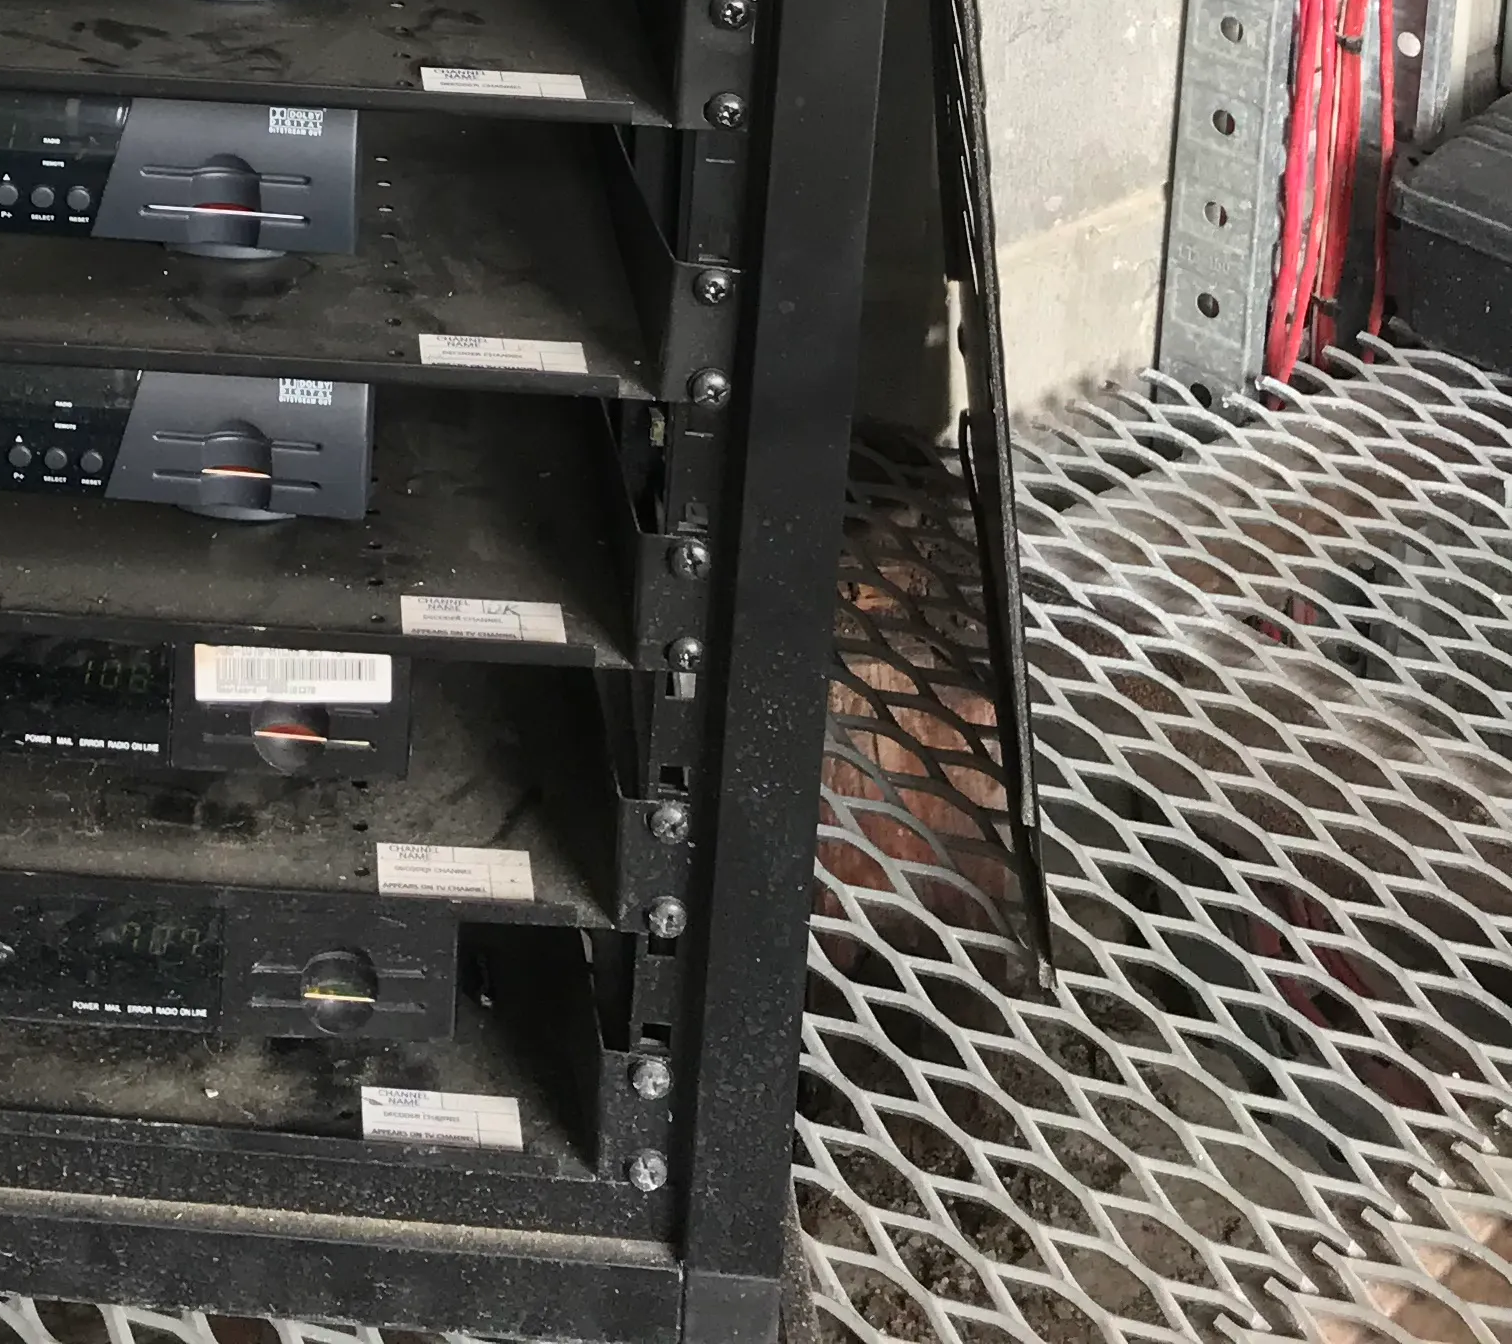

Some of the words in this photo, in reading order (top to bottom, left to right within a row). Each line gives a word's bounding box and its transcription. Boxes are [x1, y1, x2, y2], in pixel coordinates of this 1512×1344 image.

[25, 734, 52, 744] POWER
[79, 738, 105, 748] ERROR
[107, 740, 130, 750] RADIO
[73, 1001, 99, 1010] POWER
[127, 1004, 153, 1014] ERROR
[155, 1006, 178, 1015] RADIO
[378, 1090, 429, 1100] CHANNEL
[388, 1097, 421, 1106] NAME
